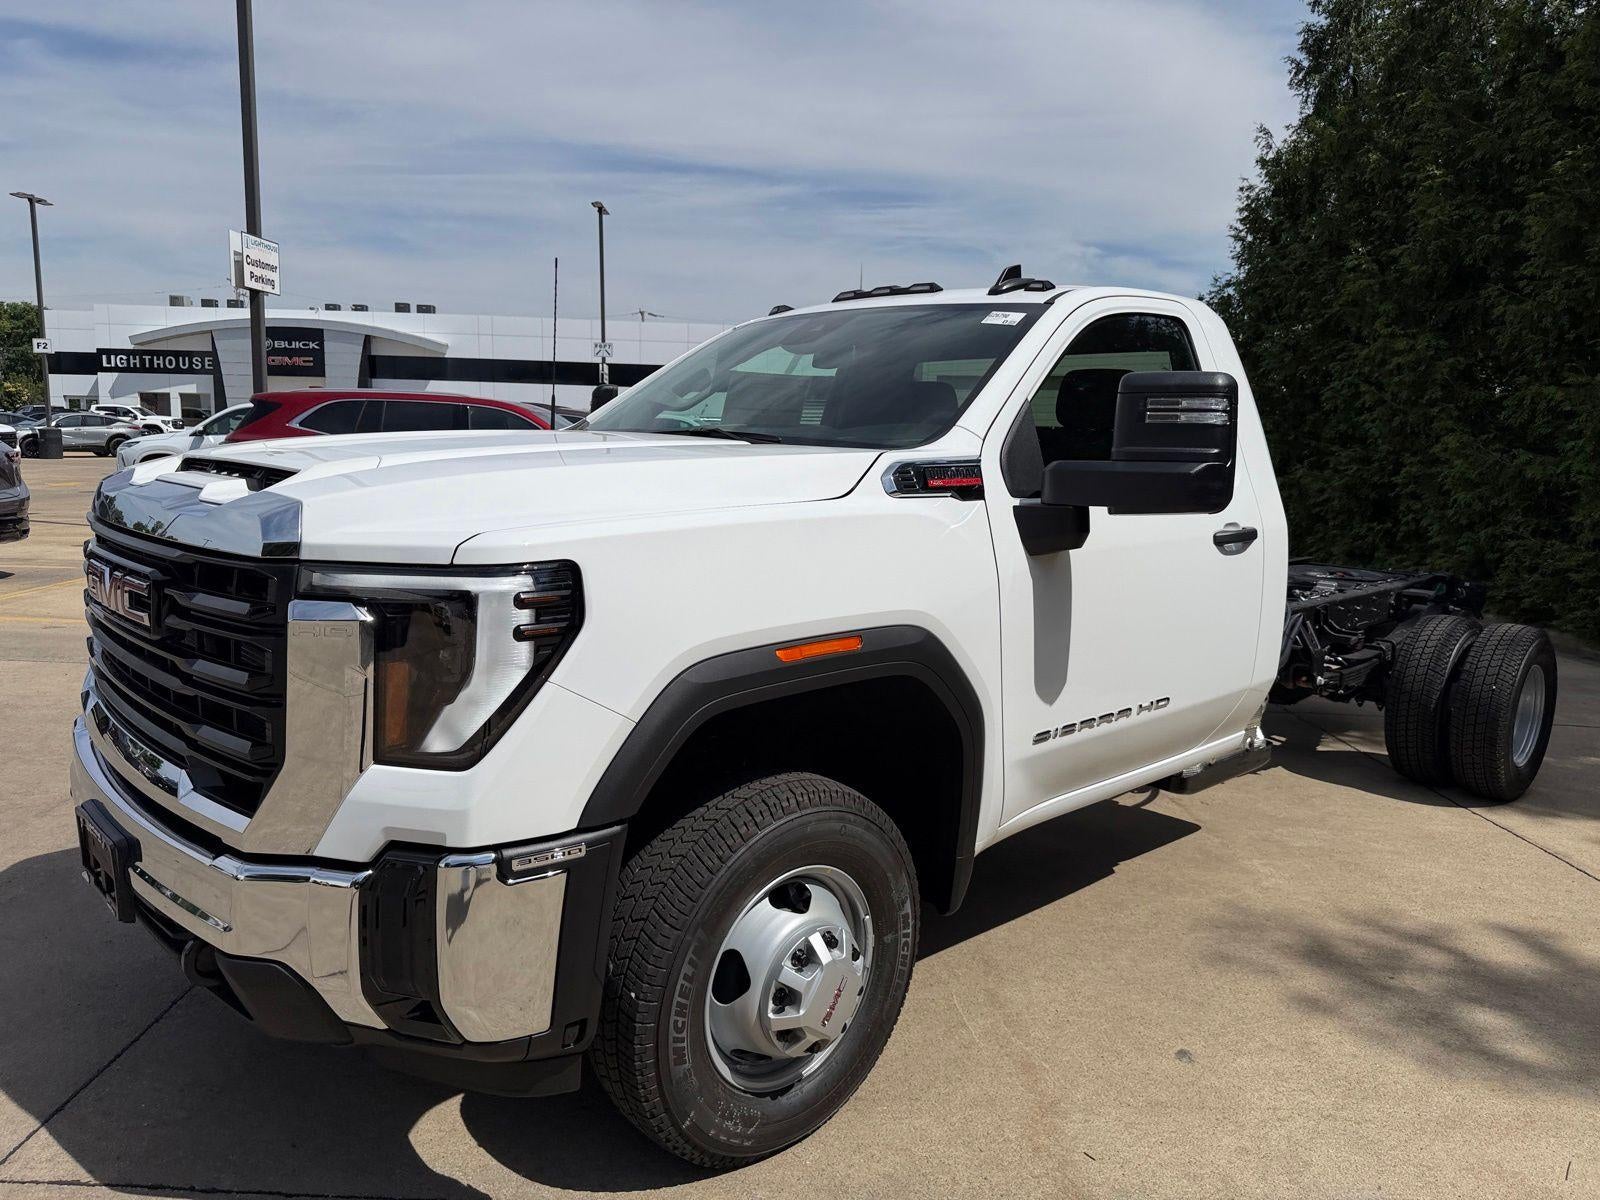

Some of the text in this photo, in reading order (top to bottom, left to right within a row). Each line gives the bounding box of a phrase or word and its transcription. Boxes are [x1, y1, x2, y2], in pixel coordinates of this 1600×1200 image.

[250, 240, 278, 253] LIGHTHOUSE
[245, 254, 278, 273] Customer
[249, 270, 276, 290] Parking
[36, 341, 49, 350] F2
[273, 340, 320, 350] BUICK
[102, 354, 214, 370] LIGHTHOUSE
[267, 356, 314, 367] GMC
[87, 558, 151, 627] GMC
[1032, 696, 1171, 746] SIERRA HD
[821, 975, 848, 1028] GMC
